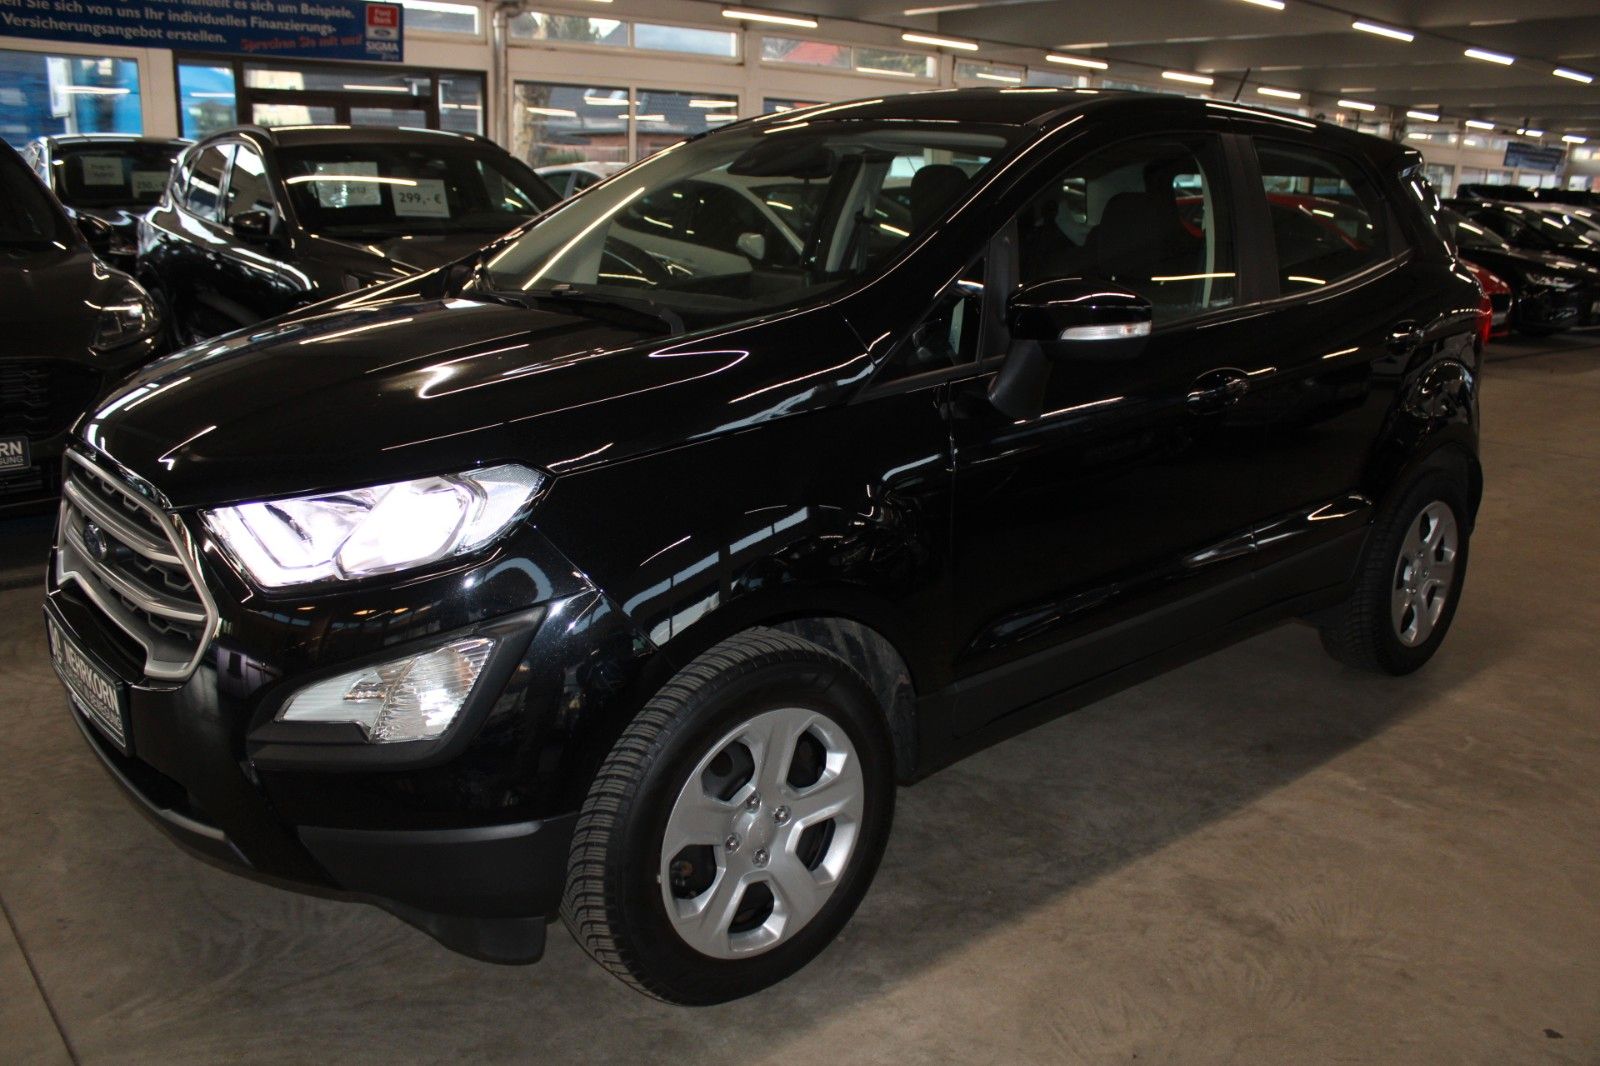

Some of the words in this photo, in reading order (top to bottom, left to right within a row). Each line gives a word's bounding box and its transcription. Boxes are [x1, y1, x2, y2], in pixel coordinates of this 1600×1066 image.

[26, 0, 49, 9] Sie
[54, 0, 82, 12] sich
[87, 5, 112, 15] von
[116, 8, 140, 18] uns
[144, 7, 165, 20] Ihr
[168, 9, 246, 27] individuelles
[250, 16, 336, 36] Finanzierungs-
[233, 1, 247, 9] es
[250, 1, 274, 12] sich
[278, 4, 297, 13] um
[300, 3, 355, 19] Beispiele.
[1, 11, 162, 39] Versicherungsangebot
[166, 30, 227, 43] erstellen.
[433, 194, 442, 204] €
[63, 640, 120, 717] NEHRKORN
